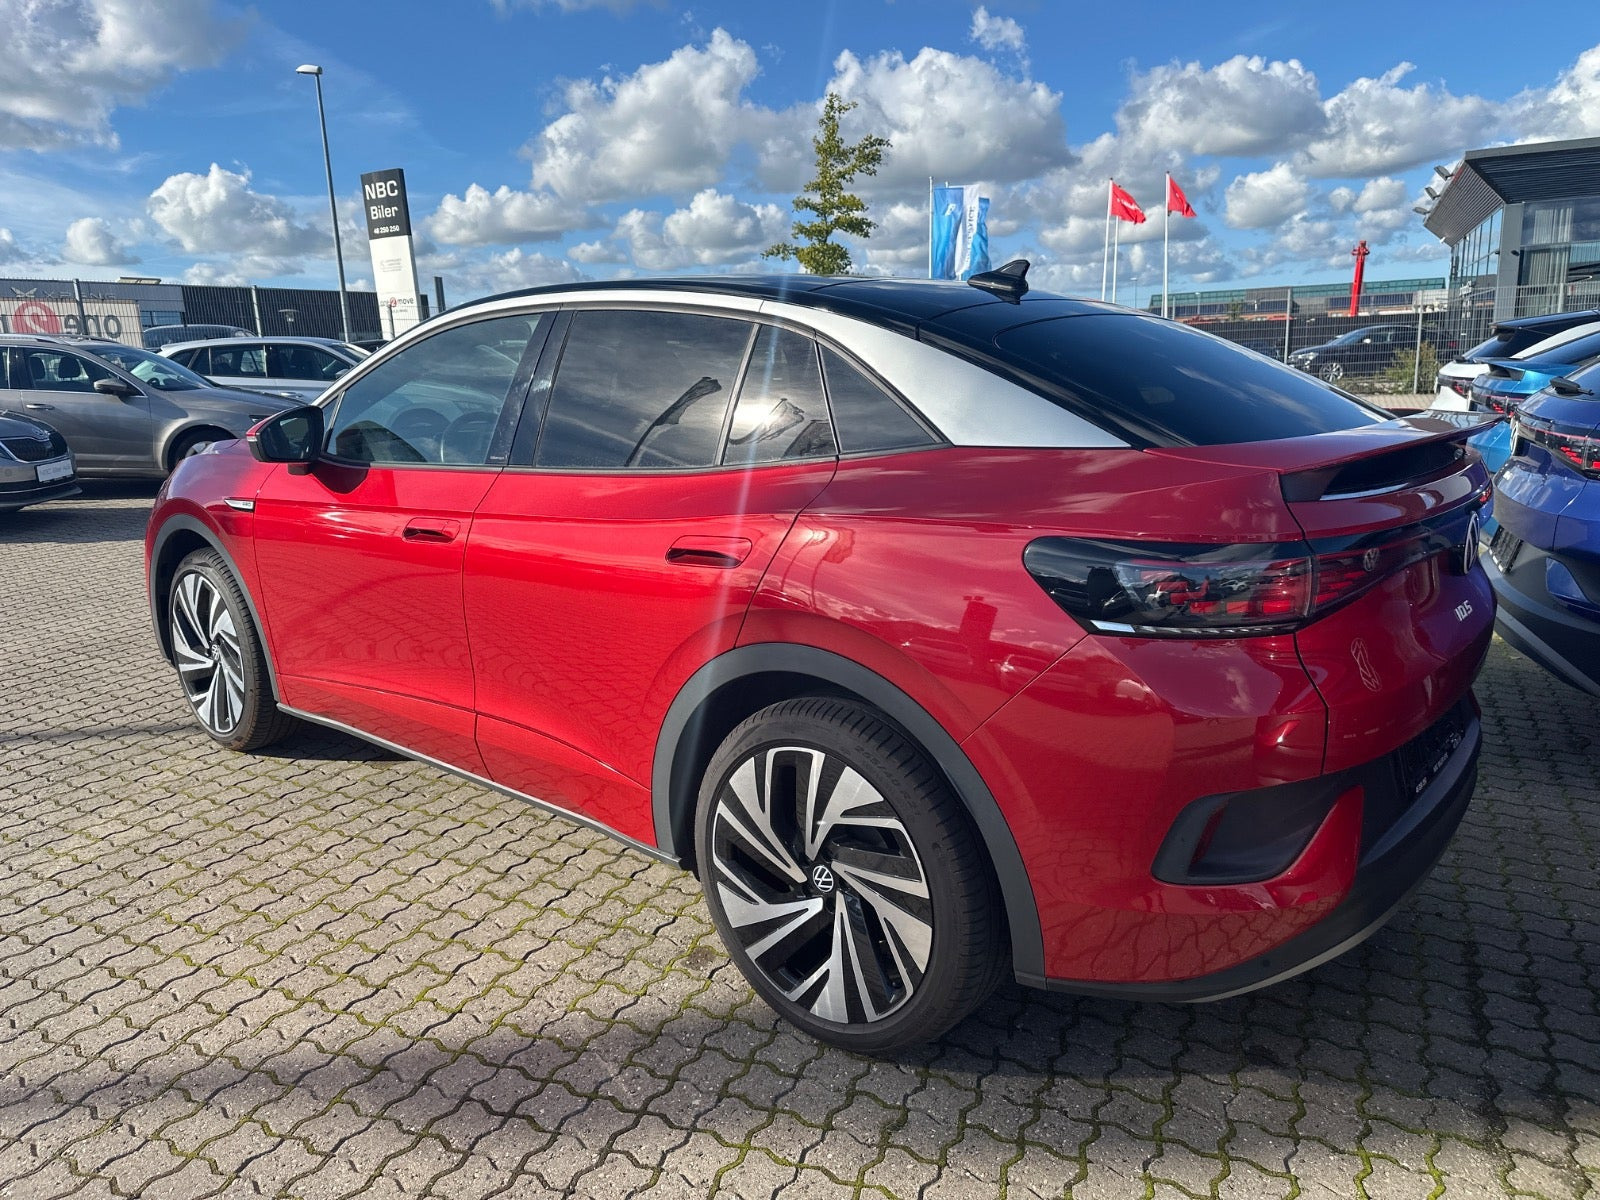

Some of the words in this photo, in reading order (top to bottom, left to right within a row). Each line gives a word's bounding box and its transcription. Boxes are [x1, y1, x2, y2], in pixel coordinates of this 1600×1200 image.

[364, 179, 398, 200] NBC
[370, 204, 398, 220] Biler
[389, 225, 399, 233] 250
